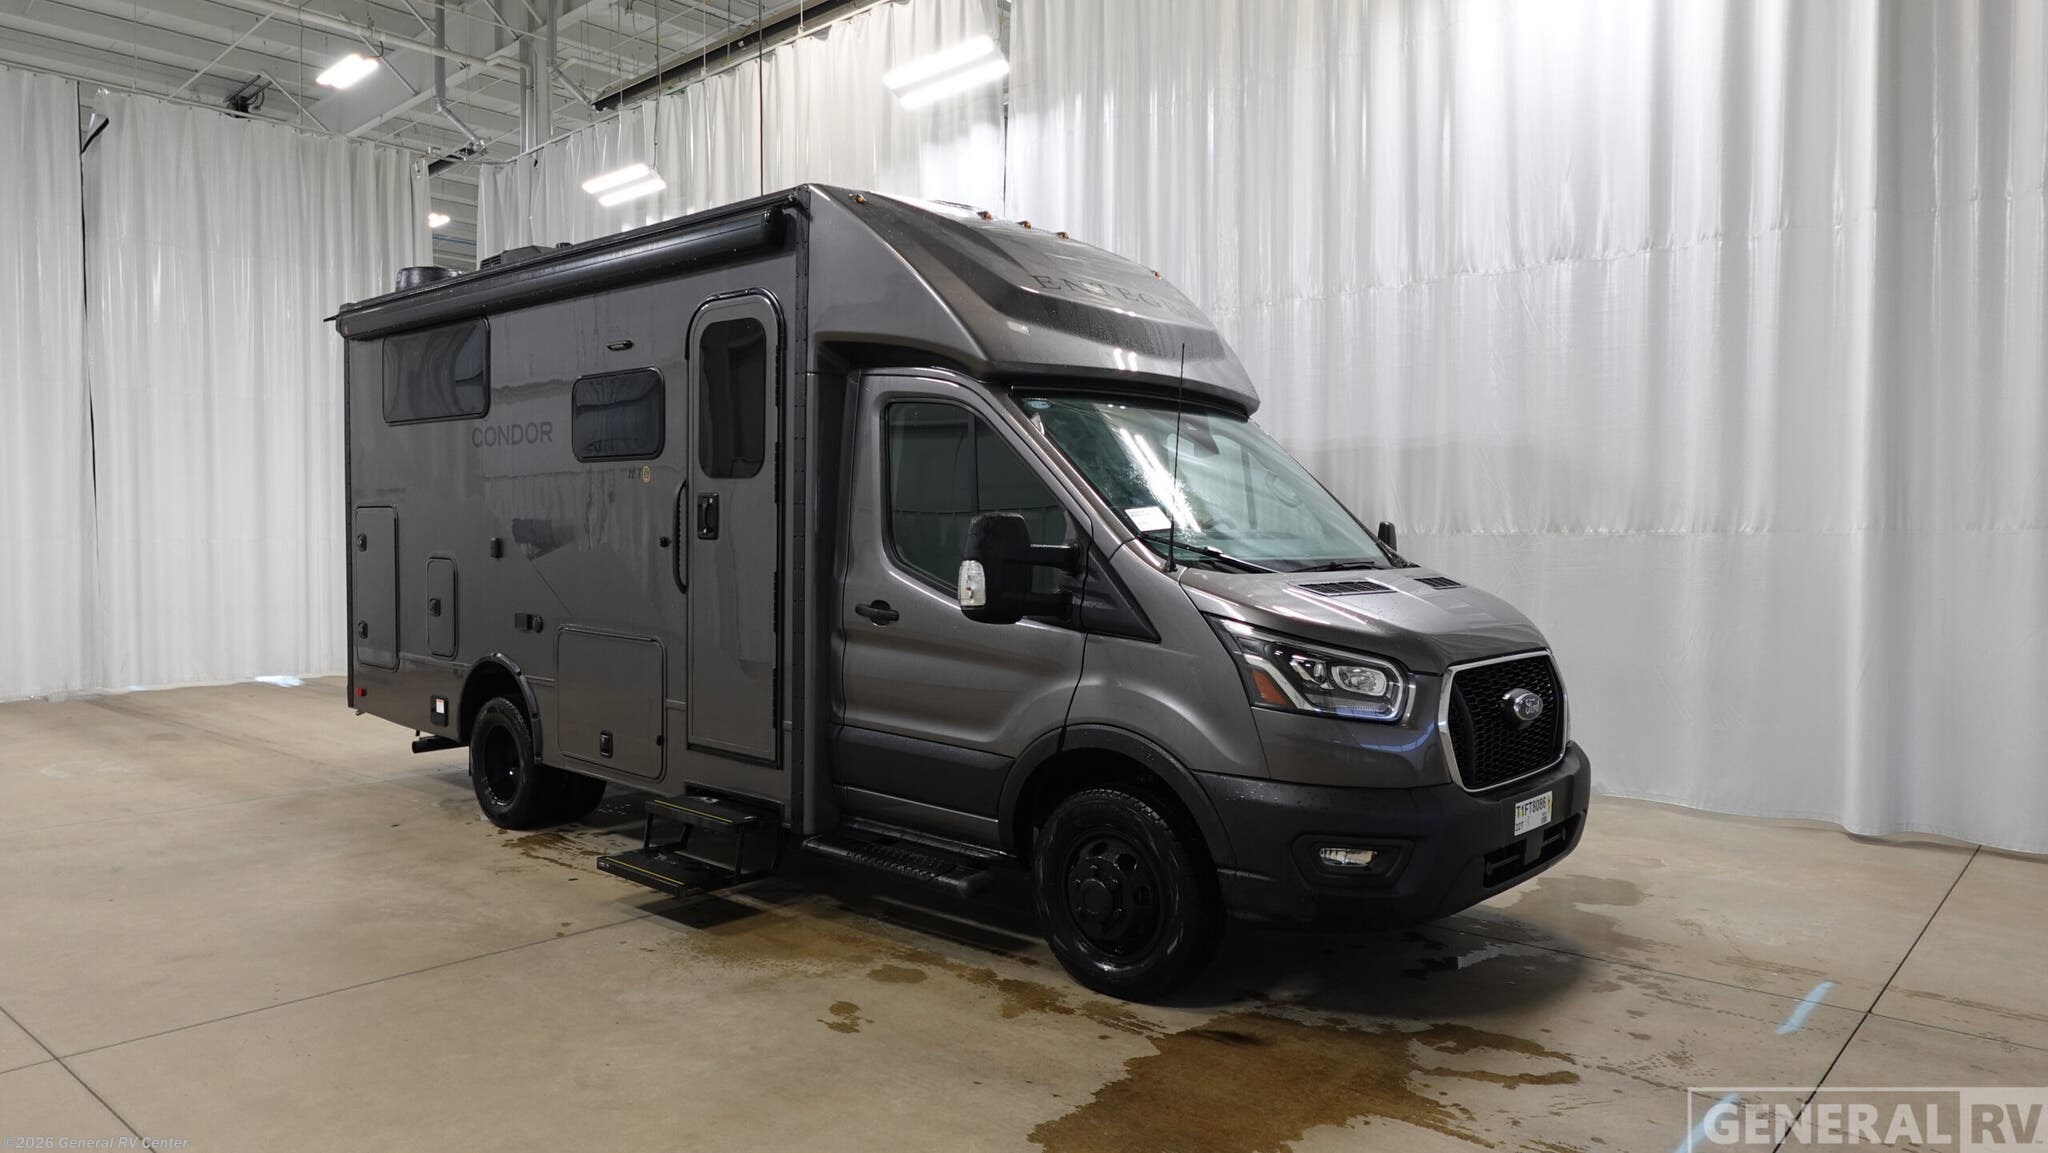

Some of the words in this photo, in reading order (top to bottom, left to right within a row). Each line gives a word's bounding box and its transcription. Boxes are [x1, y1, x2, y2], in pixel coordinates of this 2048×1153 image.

[472, 421, 553, 448] CONDOR
[1525, 697, 1540, 715] Ford
[1516, 796, 1547, 818] T1FT8086
